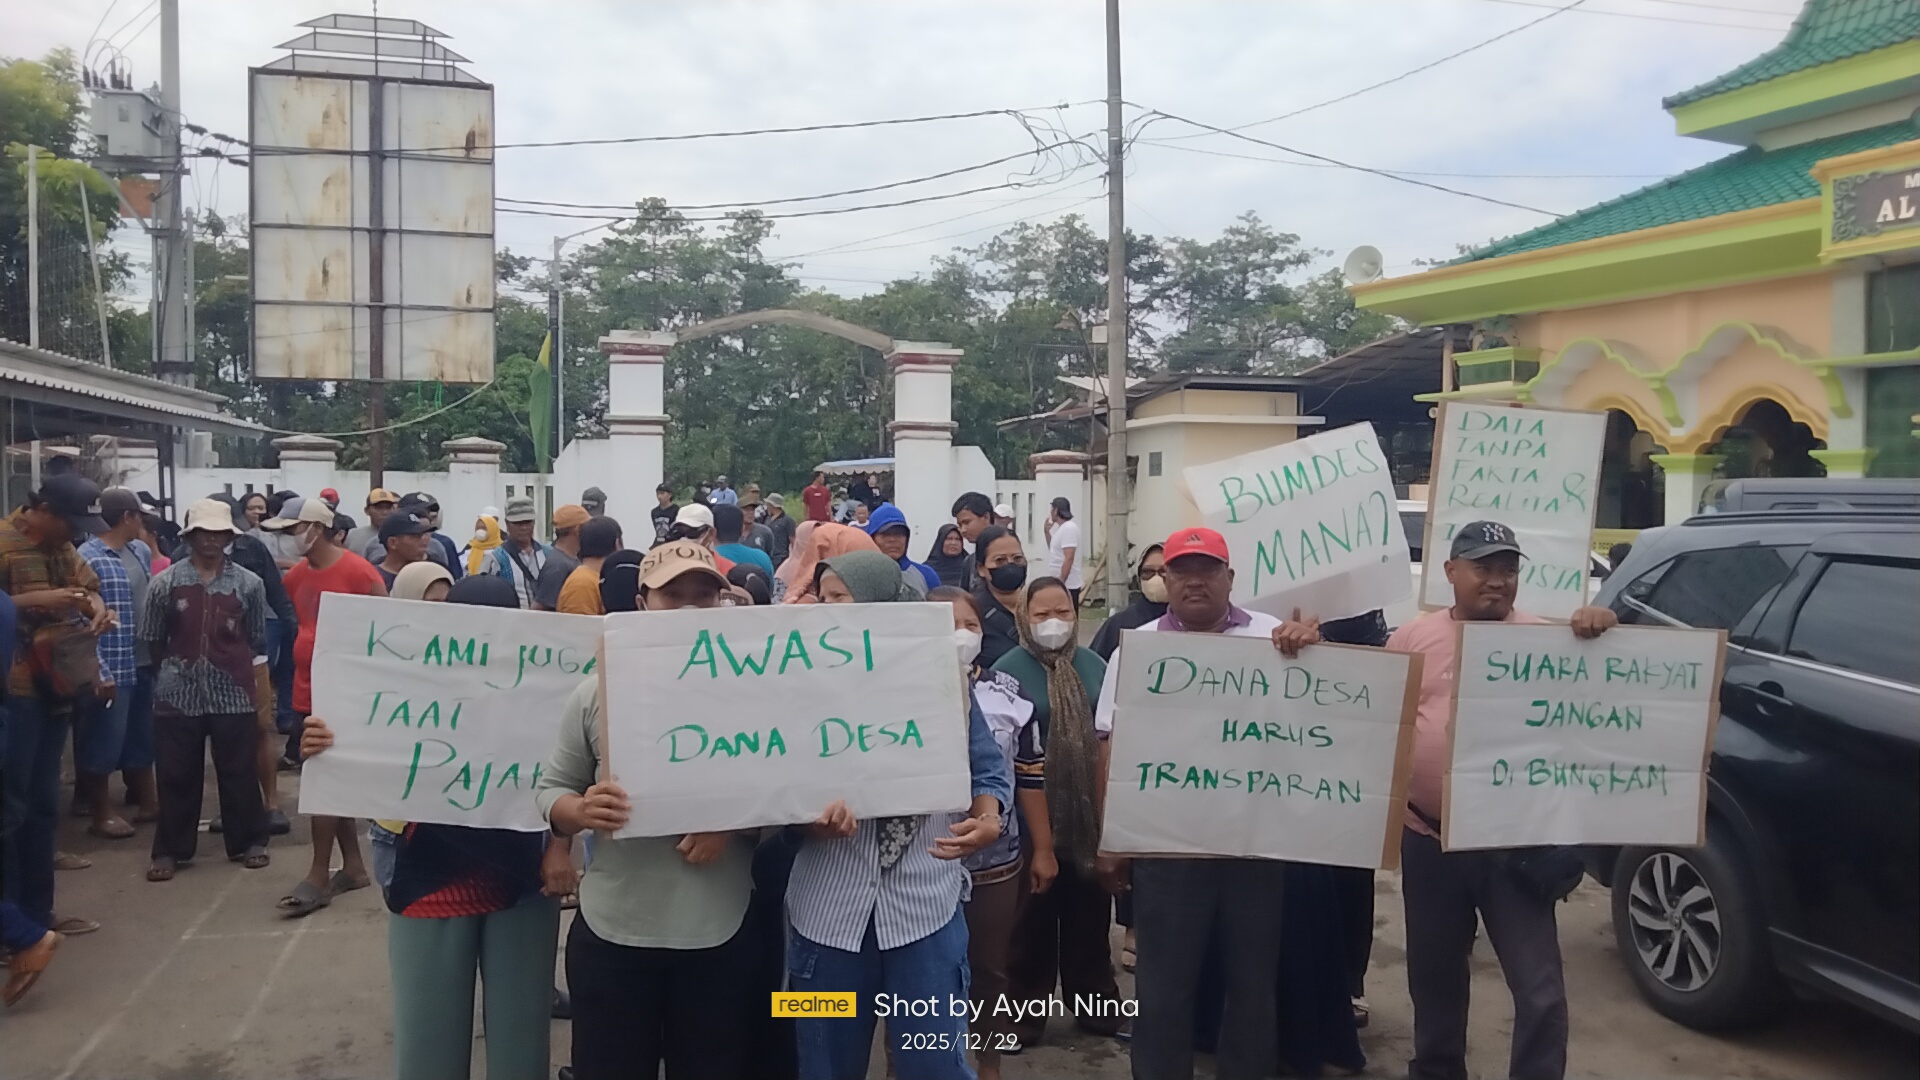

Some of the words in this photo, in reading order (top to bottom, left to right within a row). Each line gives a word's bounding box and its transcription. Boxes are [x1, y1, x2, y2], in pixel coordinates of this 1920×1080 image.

[1876, 195, 1916, 222] AL
[1457, 410, 1545, 436] DATA
[1456, 437, 1548, 458] TANPA
[1219, 440, 1379, 523] BUMDES
[1452, 459, 1538, 483] FAKTA
[1254, 490, 1389, 597] MANA?
[1518, 563, 1583, 592] ISTA
[367, 620, 491, 667] KAMI
[677, 626, 874, 680] AWASI
[1146, 656, 1270, 697] DANA
[1283, 666, 1371, 709] DESA
[1486, 651, 1589, 683] SUARA
[1606, 657, 1703, 690] RAKYAT
[363, 691, 475, 731] TAAT
[1525, 700, 1642, 732] JANGAN
[657, 724, 787, 763] DANA
[811, 718, 924, 757] DESA
[1222, 718, 1333, 747] HARUS
[1137, 762, 1361, 804] TRANSPARAN
